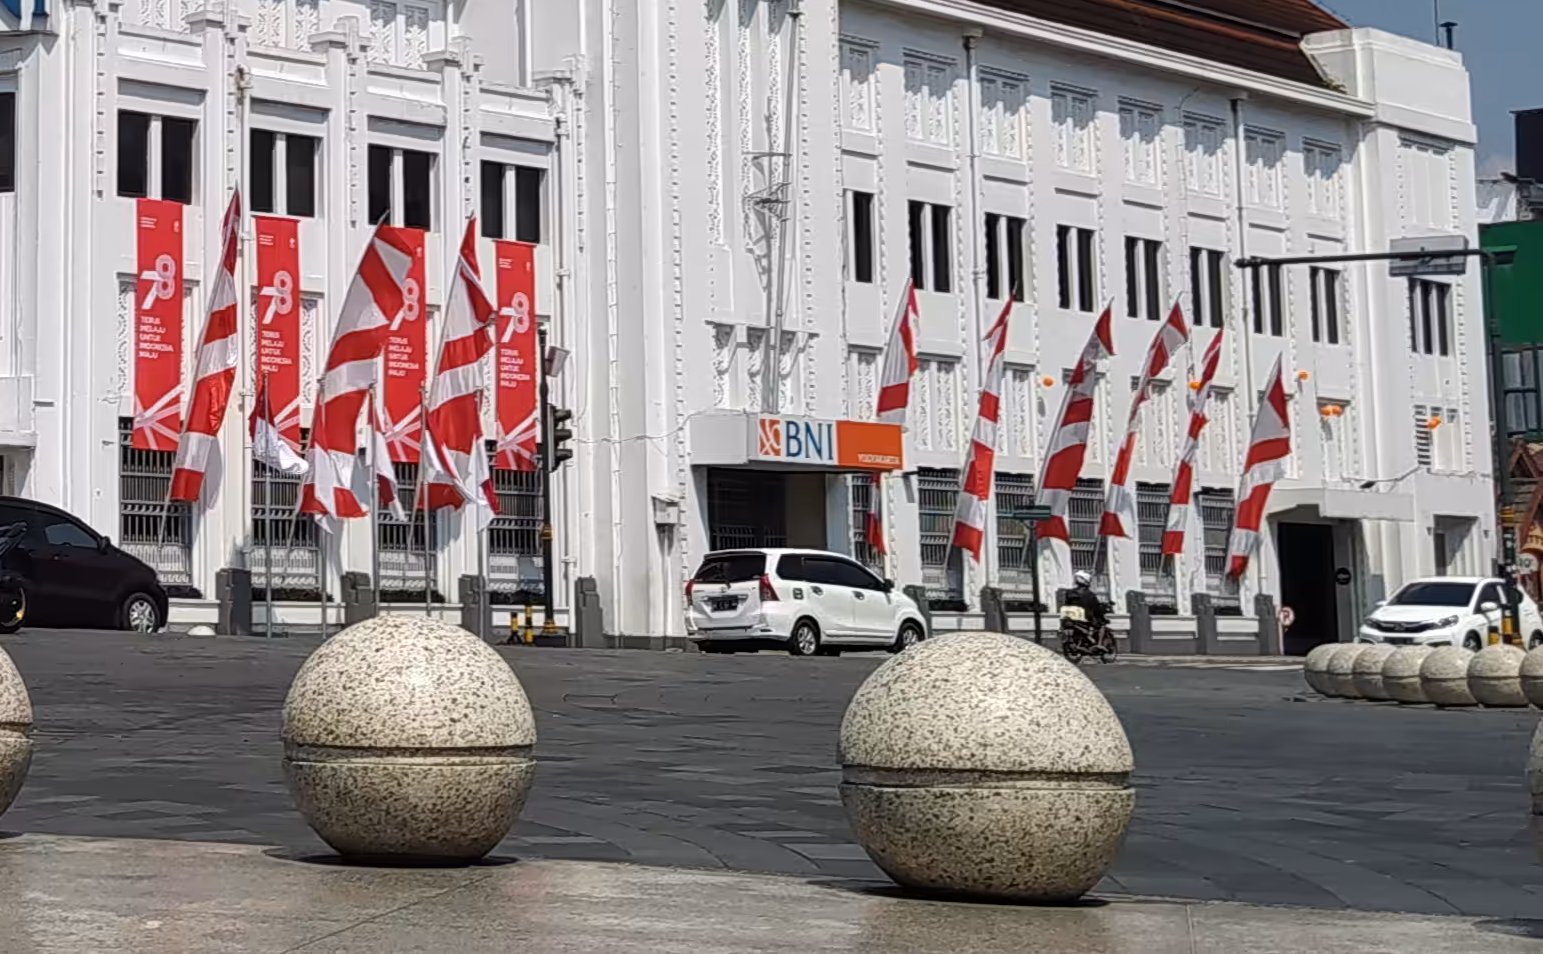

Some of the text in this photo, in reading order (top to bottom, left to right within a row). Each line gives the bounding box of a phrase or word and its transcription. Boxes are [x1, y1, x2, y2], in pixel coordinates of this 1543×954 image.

[140, 253, 176, 311] 78
[259, 270, 294, 325] 78
[499, 291, 530, 343] 78
[785, 421, 834, 460] BNI
